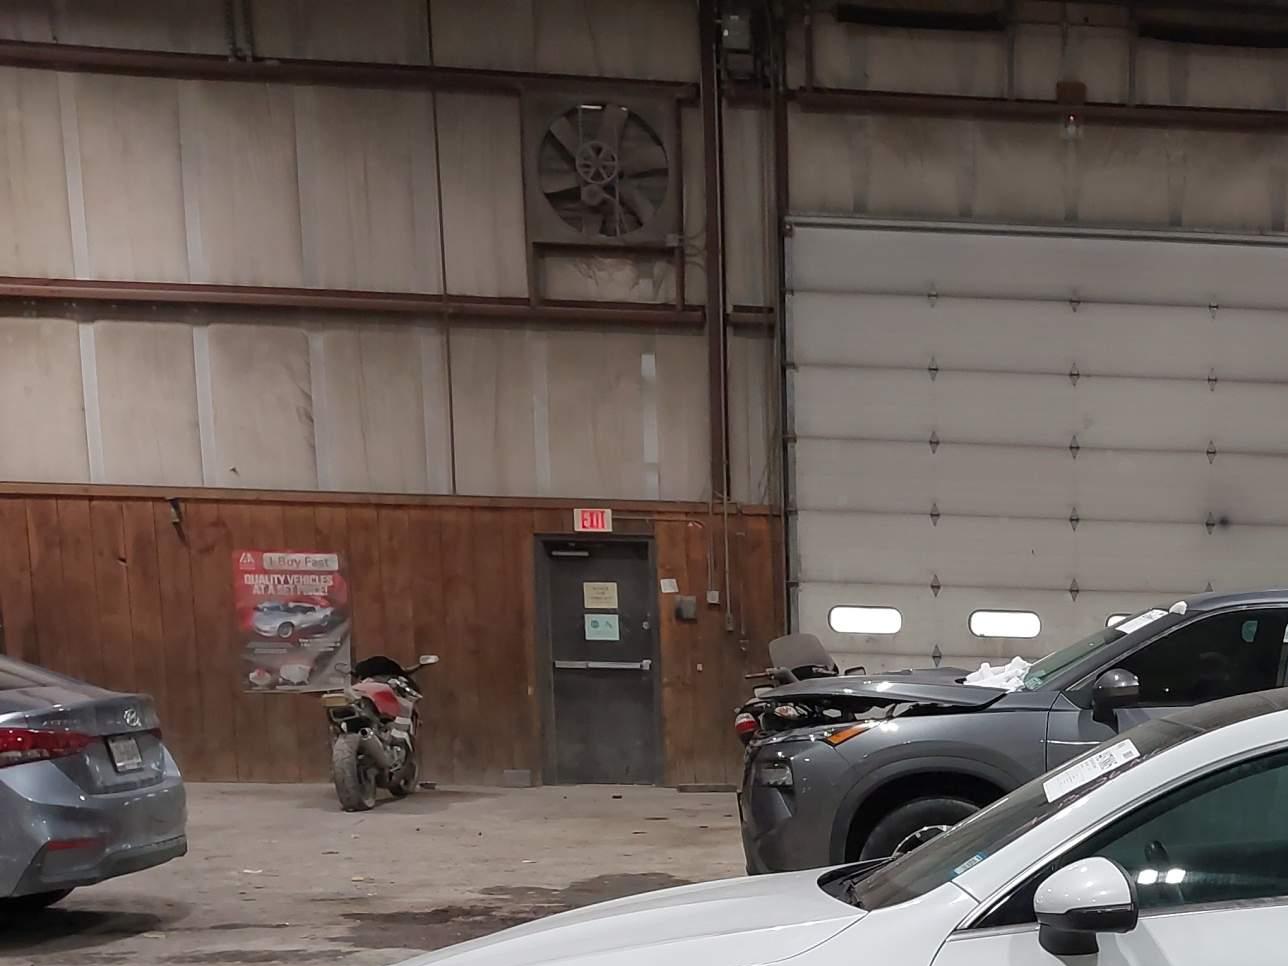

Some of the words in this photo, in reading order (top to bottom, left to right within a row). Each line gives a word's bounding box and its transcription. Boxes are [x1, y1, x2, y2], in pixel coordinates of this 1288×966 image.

[581, 511, 605, 529] EXIT
[278, 556, 301, 568] Buy
[305, 556, 329, 567] Fast
[244, 574, 286, 585] QUALITY
[287, 574, 334, 586] VEHICLES
